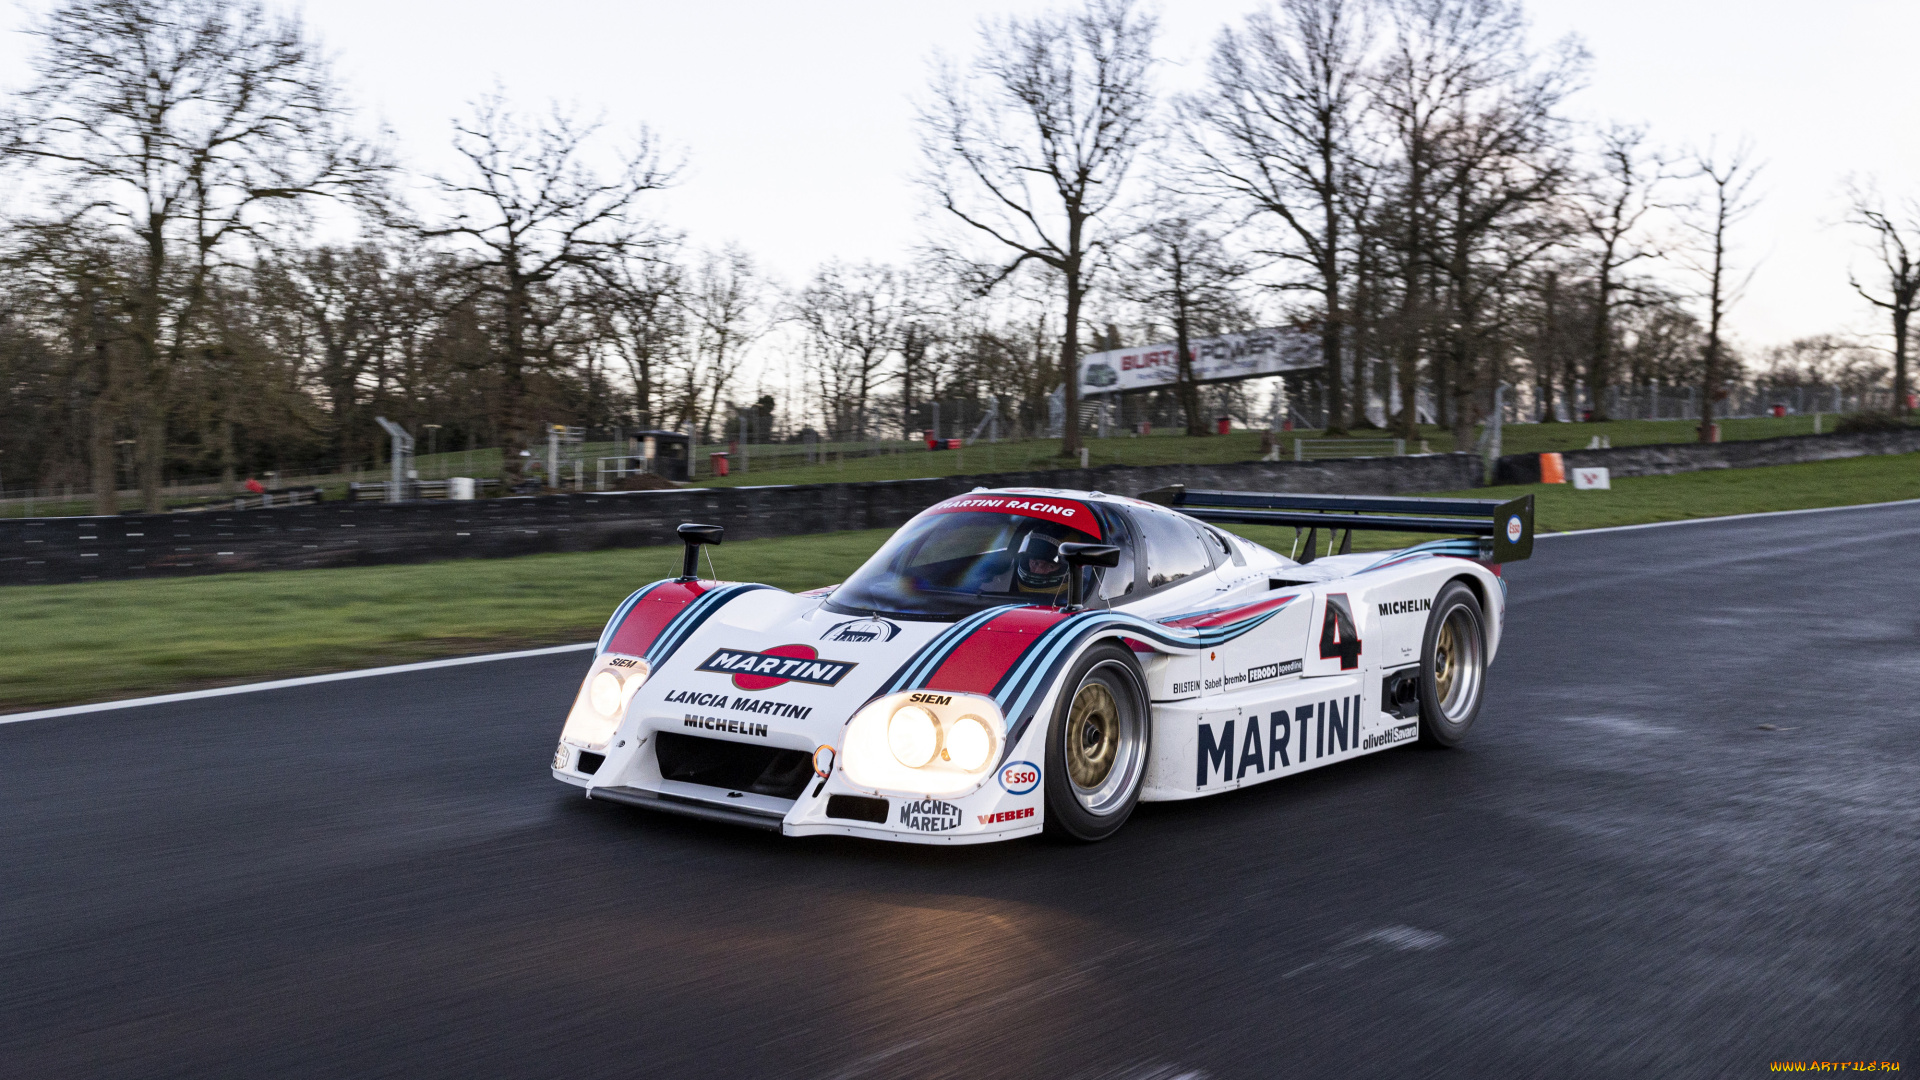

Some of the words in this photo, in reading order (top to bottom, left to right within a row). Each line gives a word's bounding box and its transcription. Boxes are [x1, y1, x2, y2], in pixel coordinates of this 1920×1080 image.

[1121, 347, 1197, 371] BURTN
[937, 499, 1004, 511] MARTINI
[1005, 500, 1076, 518] RACING
[1508, 522, 1521, 535] Esso
[1378, 598, 1431, 617] MICHELIN
[1319, 593, 1362, 671] 4
[608, 657, 638, 669] SIEM
[708, 652, 844, 681] MARTINI
[1279, 661, 1302, 674] speedline
[1224, 673, 1247, 686] brembo
[1249, 665, 1276, 681] FERODO
[1173, 680, 1200, 694] BILSTEIN
[664, 689, 729, 709] LANCIA
[730, 697, 813, 721] MARTINI
[909, 693, 952, 706] SIEM
[684, 713, 768, 738] MICHELIN
[1196, 694, 1361, 787] MARTINI
[1363, 729, 1393, 750] olivetti
[1005, 769, 1036, 784] Esso
[977, 807, 1035, 825] WEBER
